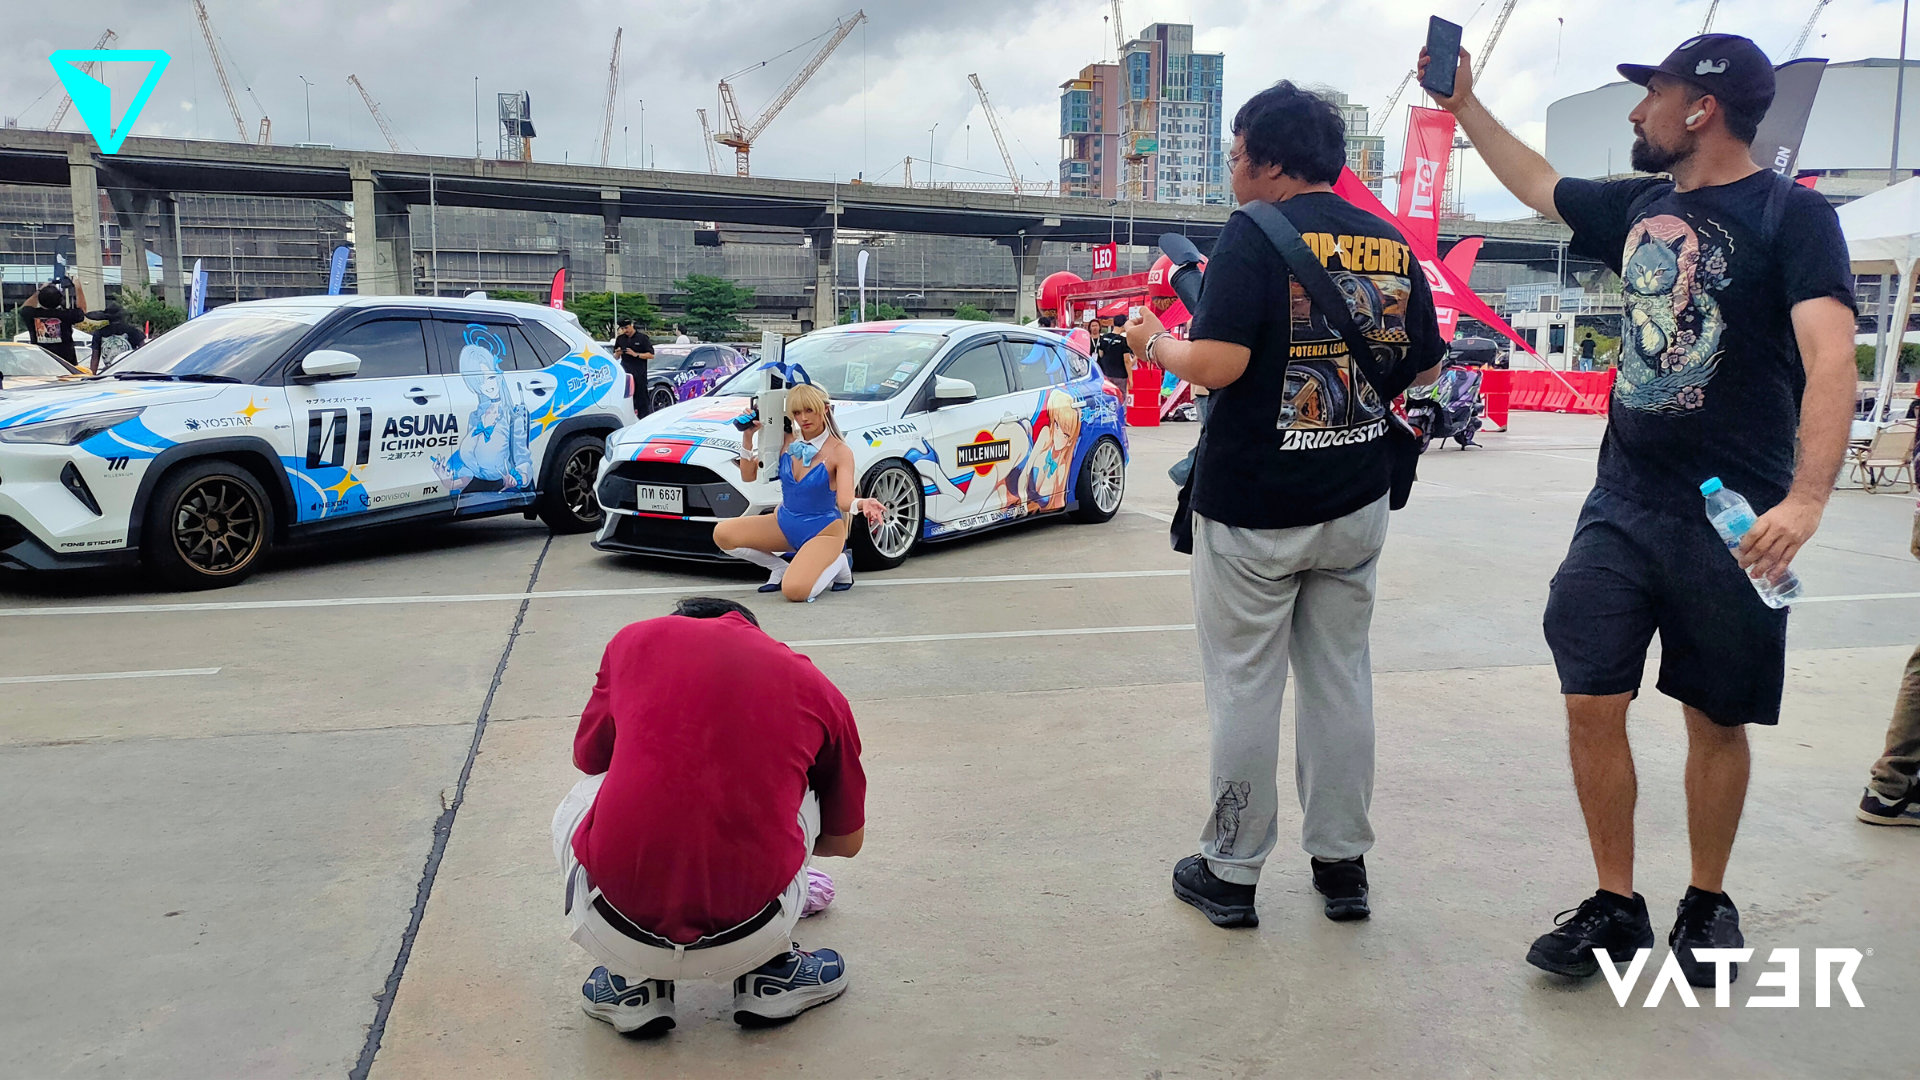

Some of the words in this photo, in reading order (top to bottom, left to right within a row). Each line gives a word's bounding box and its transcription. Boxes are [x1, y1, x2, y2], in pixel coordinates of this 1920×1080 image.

[1414, 163, 1434, 213] LEO
[1094, 248, 1112, 270] LEO
[1302, 232, 1335, 268] OP
[1338, 234, 1410, 276] SECRET
[1289, 344, 1328, 357] POTENZA
[201, 416, 253, 428] YOSTAR
[381, 413, 459, 438] ASUNA
[870, 422, 918, 438] NEXON
[306, 406, 373, 469] 01
[380, 435, 459, 452] ICHINOSE
[958, 443, 1009, 464] MILLENNIUM
[659, 488, 681, 501] 6637
[318, 499, 349, 510] NEXON
[87, 538, 123, 547] STICKER
